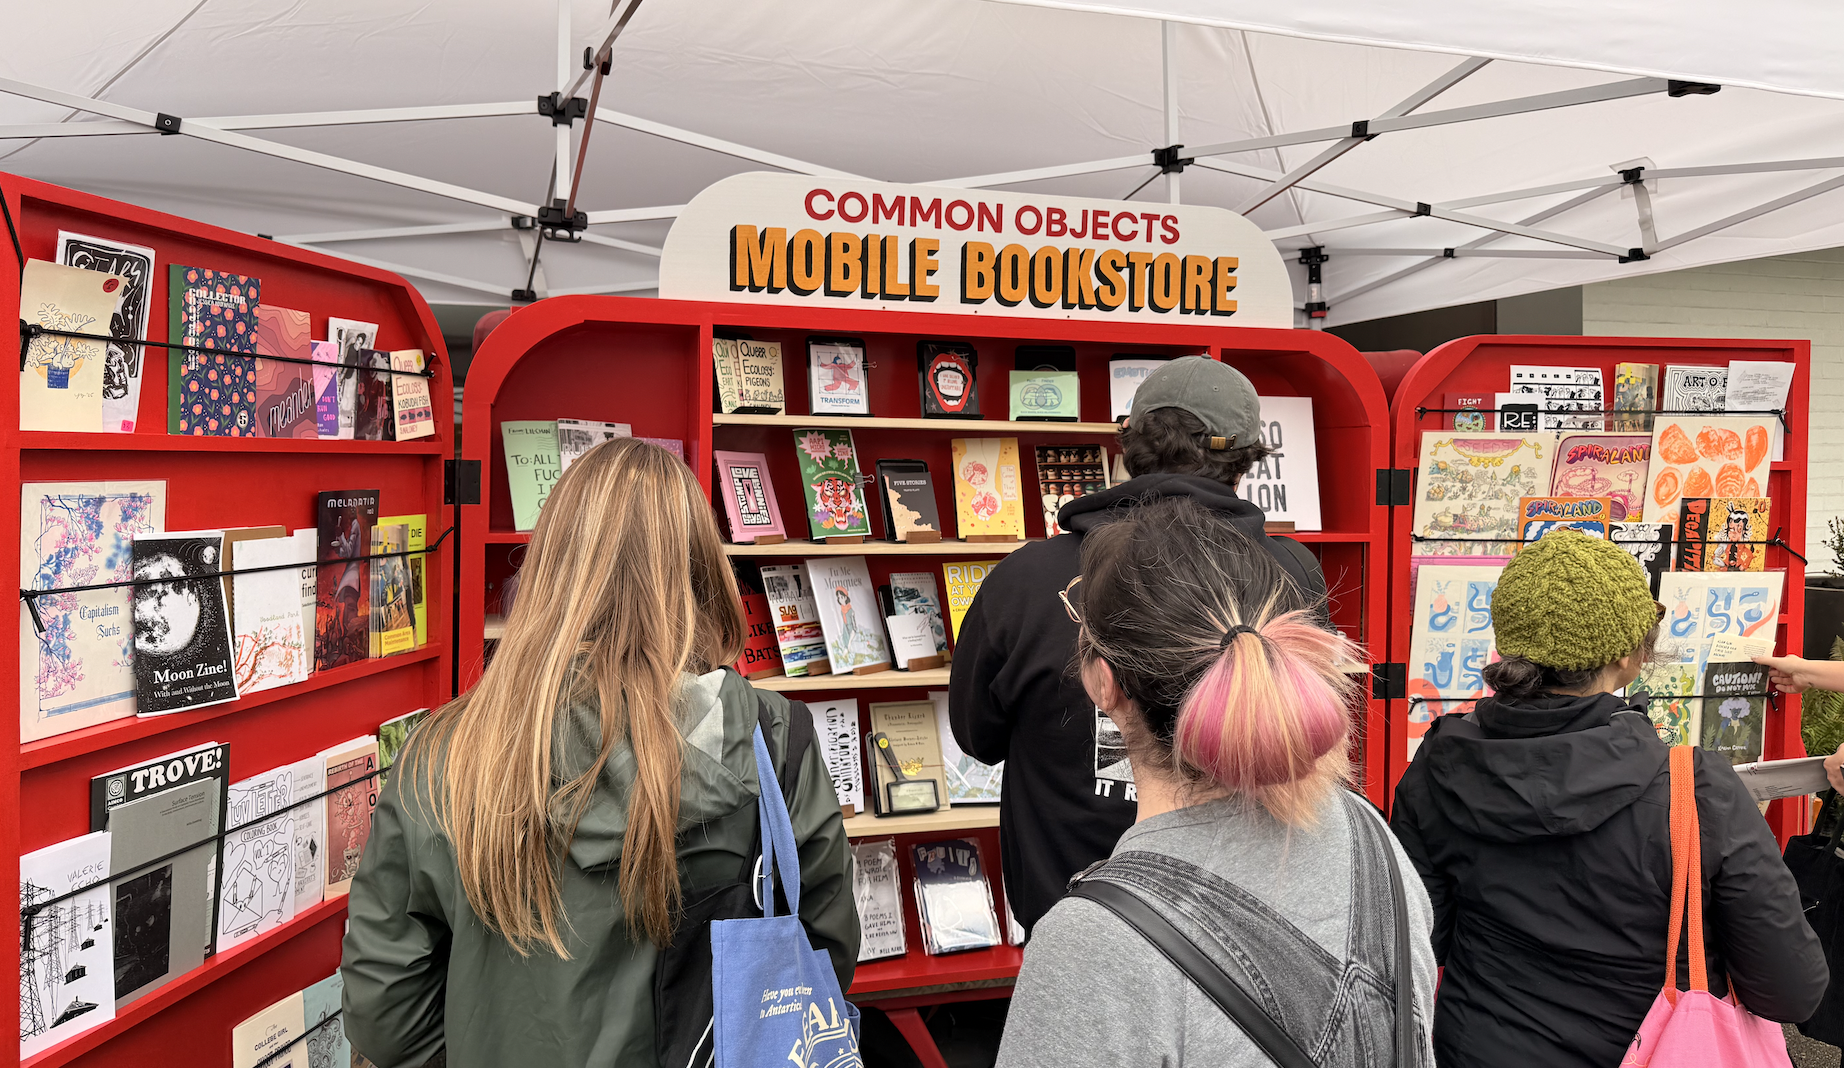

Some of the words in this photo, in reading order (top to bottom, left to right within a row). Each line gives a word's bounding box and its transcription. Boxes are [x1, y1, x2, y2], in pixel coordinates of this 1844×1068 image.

[804, 188, 1003, 234] COMMON
[1014, 205, 1181, 245] OBJECTS
[729, 224, 941, 302] MOBILE
[960, 241, 1239, 316] BOOKSTORE
[189, 288, 246, 304] COLLECTOR
[745, 377, 771, 387] PIGEONS
[1684, 376, 1705, 388] ART
[269, 367, 313, 436] meander
[820, 397, 860, 405] TRANSFORM
[1457, 398, 1482, 406] FIGHT
[1504, 412, 1537, 428] RE:
[1260, 420, 1283, 449] SO
[1461, 441, 1510, 454] SEEDS
[533, 454, 557, 466] ALL
[534, 469, 560, 481] FUC
[731, 467, 759, 479] LOVE
[1525, 499, 1603, 518] SPIRALAND
[411, 528, 422, 538] DIE
[828, 567, 839, 577] Tu
[840, 566, 851, 576] Me
[824, 577, 862, 591] Manques
[951, 585, 965, 595] AT
[79, 603, 119, 623] Capitalism
[287, 610, 299, 618] Park
[744, 600, 753, 615] I
[96, 622, 121, 641] Sucks
[153, 668, 194, 684] Moon
[196, 660, 228, 677] Zine!
[1712, 672, 1763, 687] CAUTION!
[153, 691, 171, 699] With
[171, 687, 183, 696] and
[183, 685, 204, 694] Without
[204, 683, 213, 691] the
[213, 680, 230, 689] Moon
[131, 747, 222, 793] TROVE!
[1094, 778, 1115, 798] IT
[243, 826, 266, 841] COLORING
[266, 822, 278, 835] BOOK
[863, 858, 883, 867] POEM
[67, 860, 104, 883] VALERIE
[873, 874, 889, 883] HIM
[71, 875, 100, 892] ECHO
[869, 913, 887, 921] POEMS
[865, 922, 878, 930] GAVE
[761, 988, 779, 1003] Have
[777, 987, 794, 1003] you
[254, 1033, 277, 1051] COLLEGE
[277, 1027, 289, 1038] GIRL
